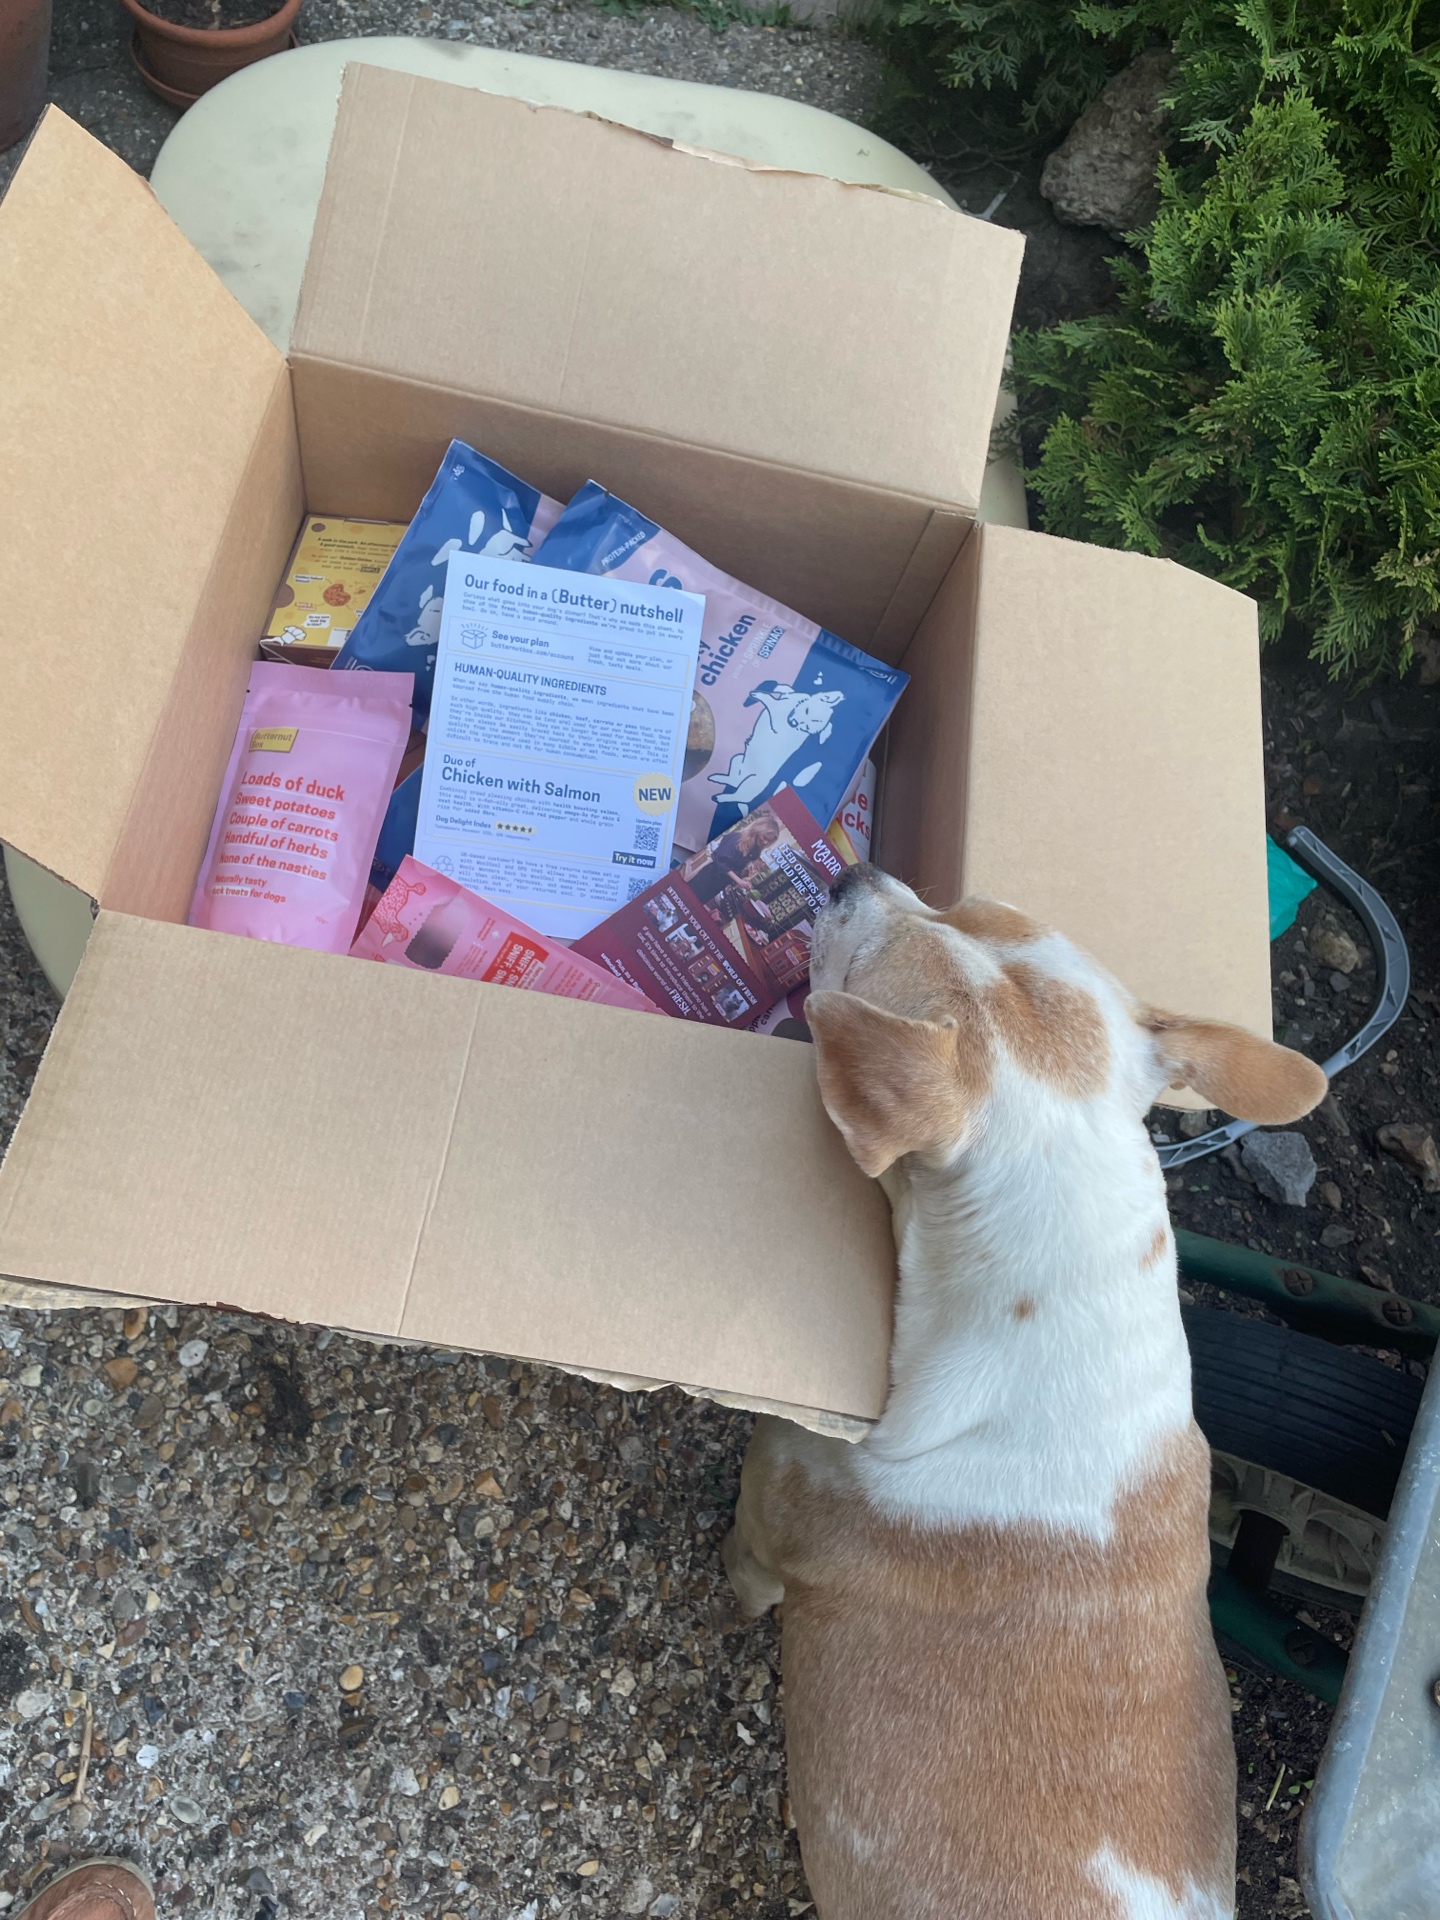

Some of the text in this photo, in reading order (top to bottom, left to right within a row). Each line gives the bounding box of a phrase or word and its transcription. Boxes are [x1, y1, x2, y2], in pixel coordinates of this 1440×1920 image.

[464, 573, 683, 623] Our food in a (Butter) nutshell
[490, 641, 574, 660] butternutbox.com/account
[491, 630, 549, 649] See your plan
[701, 615, 756, 686] chicken
[743, 622, 771, 659] SPRINKLE
[454, 662, 607, 696] HUMAN-QUALITY INGREDIENTS
[252, 741, 263, 749] Box
[254, 732, 293, 742] Butternut
[443, 754, 476, 767] Duo of
[242, 771, 345, 801] Loads of duck
[441, 765, 601, 802] Chicken with Salmon
[638, 786, 671, 801] NEW
[235, 792, 336, 820] Sweet potatoes
[435, 814, 491, 828] Dog Delight Index
[229, 812, 339, 842] Couple of carrots
[224, 831, 328, 859] Handful of herbs
[613, 852, 654, 866] Try it now
[810, 839, 842, 878] MARR
[215, 874, 267, 888] Naturally tasty
[219, 853, 327, 881] None of the nasties
[770, 848, 821, 915] WOULD LIKE TO B
[778, 842, 828, 906] FEED OTHERS HO
[225, 888, 249, 896] treats
[249, 888, 263, 898] for
[264, 891, 286, 903] dogs
[499, 941, 524, 972] SNIFF,
[666, 885, 690, 916] INTRODUCE
[687, 914, 701, 931] YOUR
[698, 928, 709, 941] CAT
[706, 940, 716, 950] TO
[713, 948, 724, 961] THE
[721, 959, 738, 980] WORLD
[734, 977, 744, 988] OF
[741, 985, 757, 1005] FRESH
[510, 946, 535, 976] SNIFF,
[644, 930, 655, 942] you
[653, 939, 665, 954] have
[665, 956, 674, 967] cat
[671, 965, 678, 973] or
[679, 975, 694, 992] friend
[690, 990, 702, 1004] who
[699, 1001, 709, 1013] has
[635, 947, 691, 1016] delicious world of FRESH.
[649, 948, 661, 962] time
[658, 960, 666, 968] to
[663, 966, 684, 992] introduce
[681, 990, 693, 1005] them
[691, 1003, 698, 1011] to
[695, 1009, 705, 1020] the
